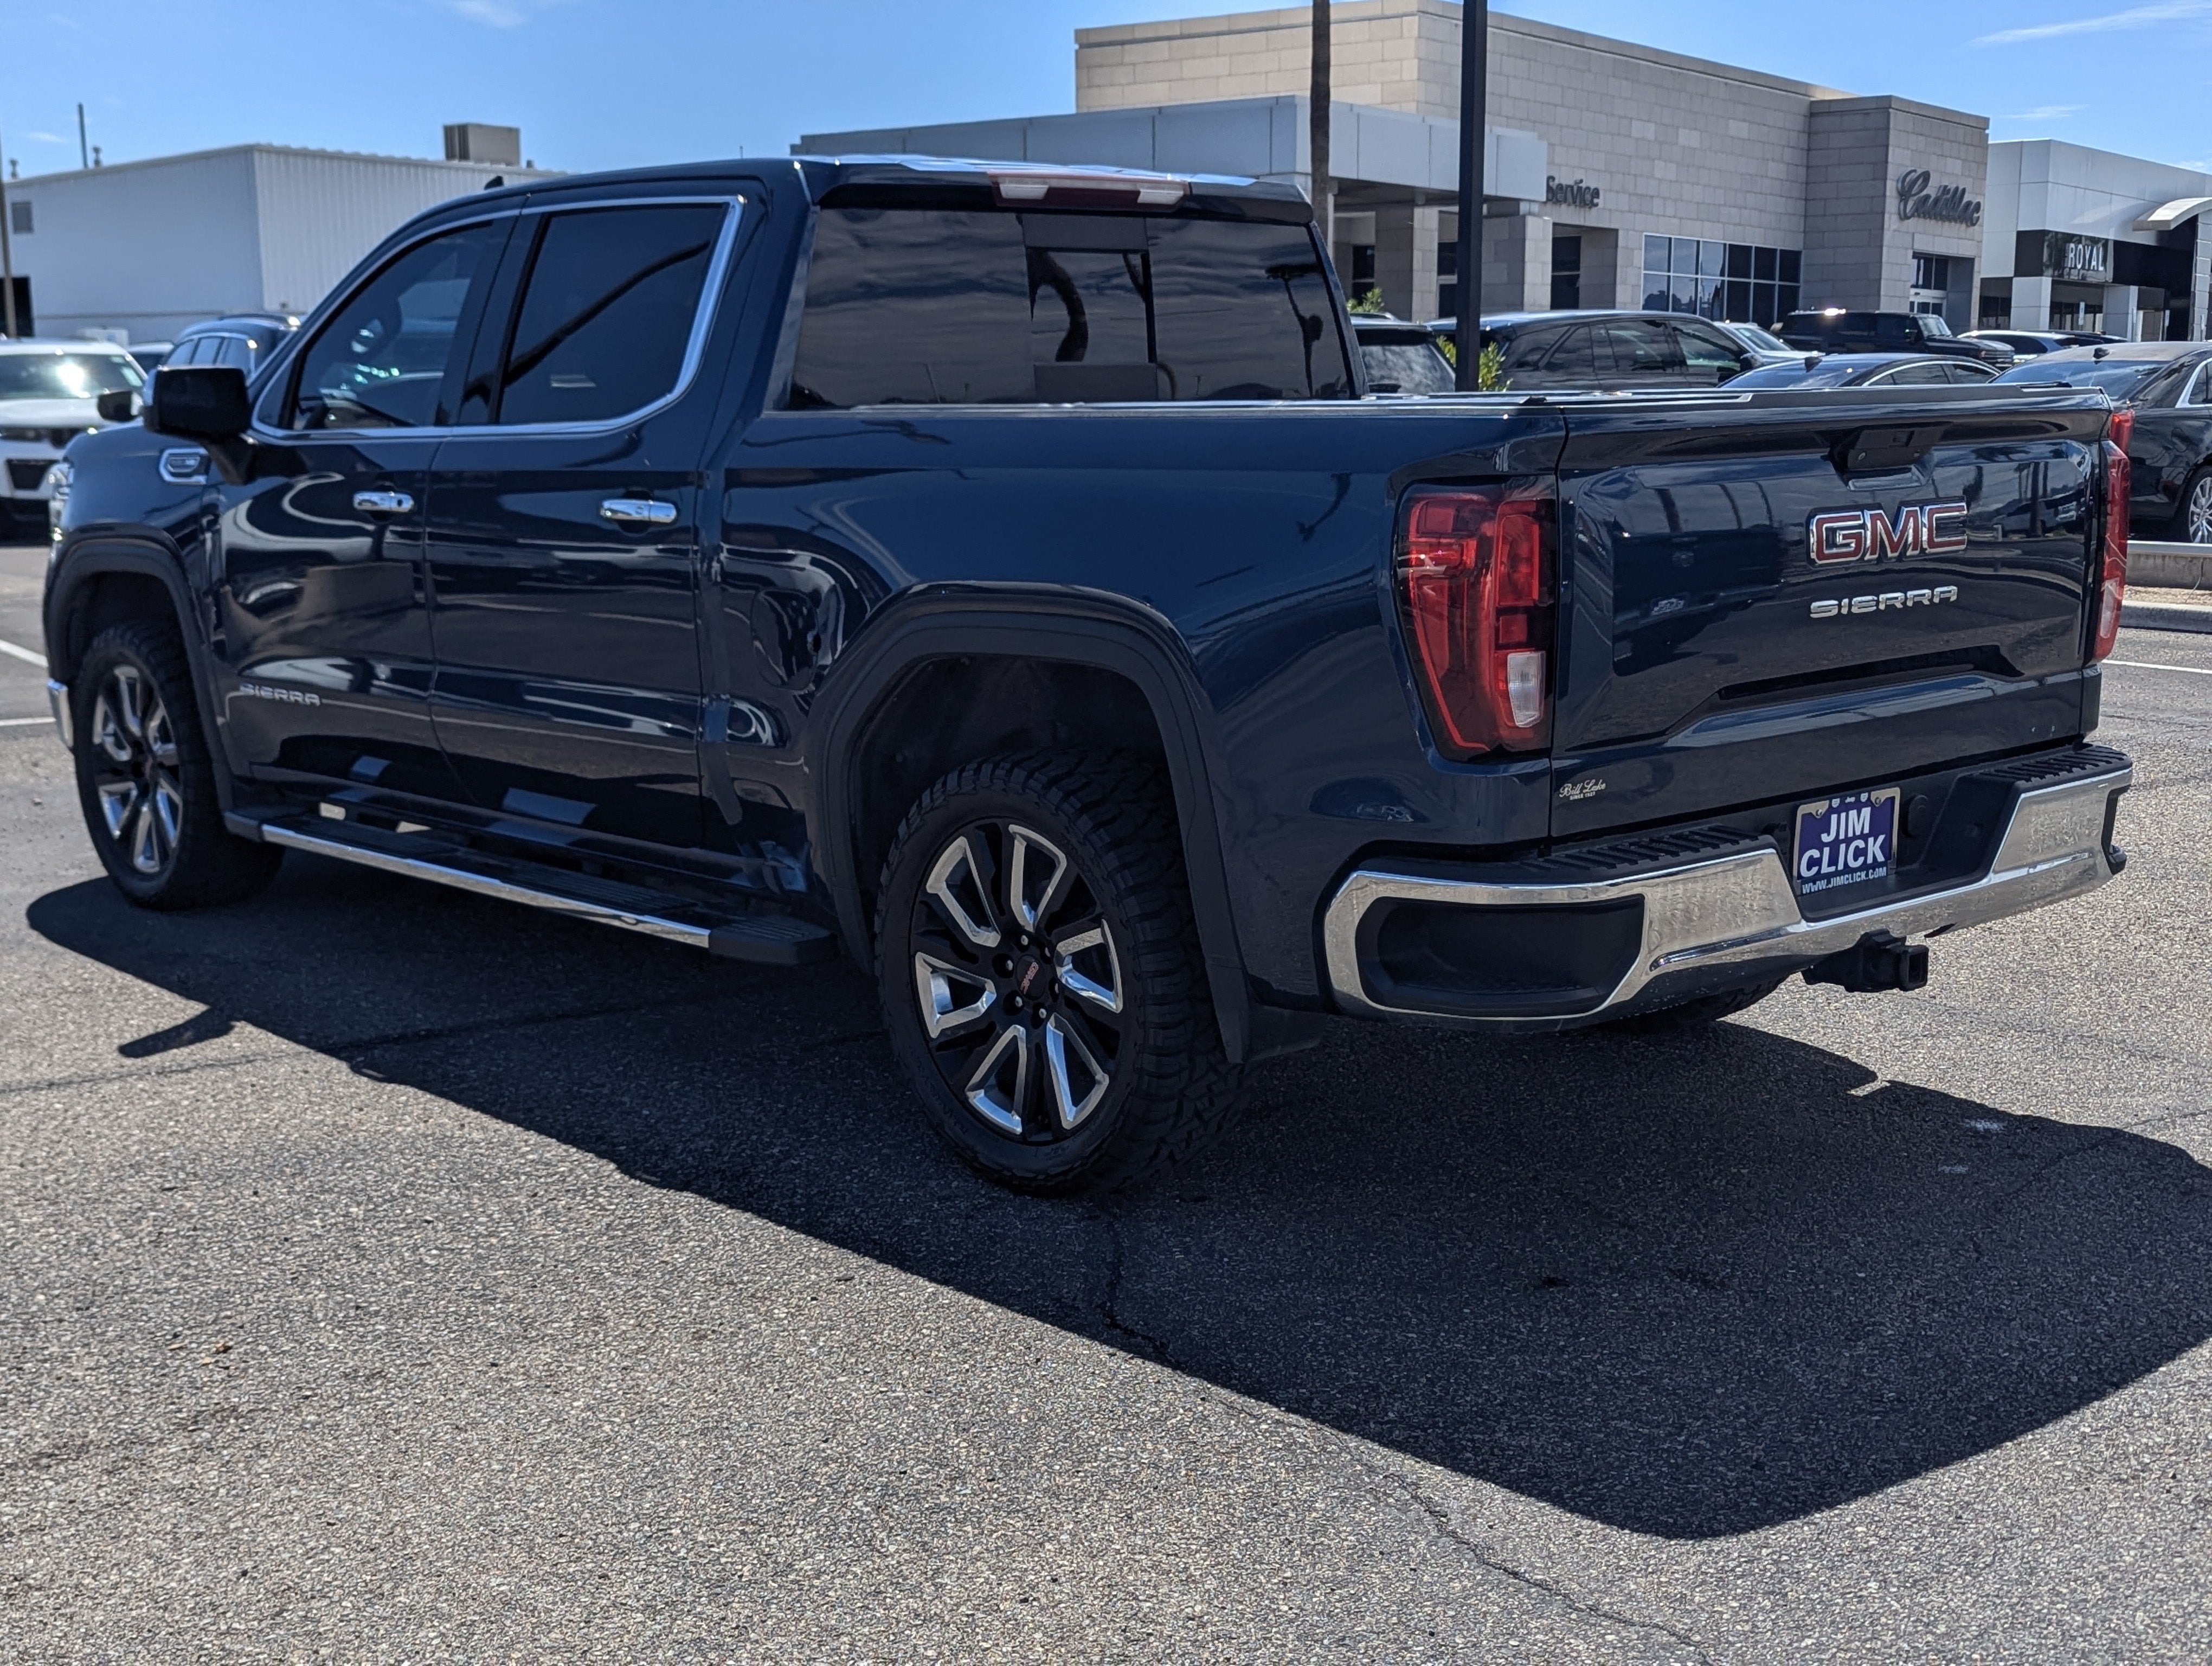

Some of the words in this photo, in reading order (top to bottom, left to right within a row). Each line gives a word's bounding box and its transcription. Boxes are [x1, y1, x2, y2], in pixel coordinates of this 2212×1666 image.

[1546, 175, 1600, 207] Service
[1897, 169, 1981, 227] Cadillac
[2066, 243, 2104, 271] ROYAL
[1809, 502, 1968, 565] GMC
[1810, 585, 1958, 618] SIERRA
[239, 682, 321, 706] SIERRA
[1559, 783, 1583, 798] Bill
[1821, 806, 1871, 843] JIM
[1799, 834, 1886, 877] CLICK
[1802, 867, 1887, 894] WWW.JIMCLICK.COM
